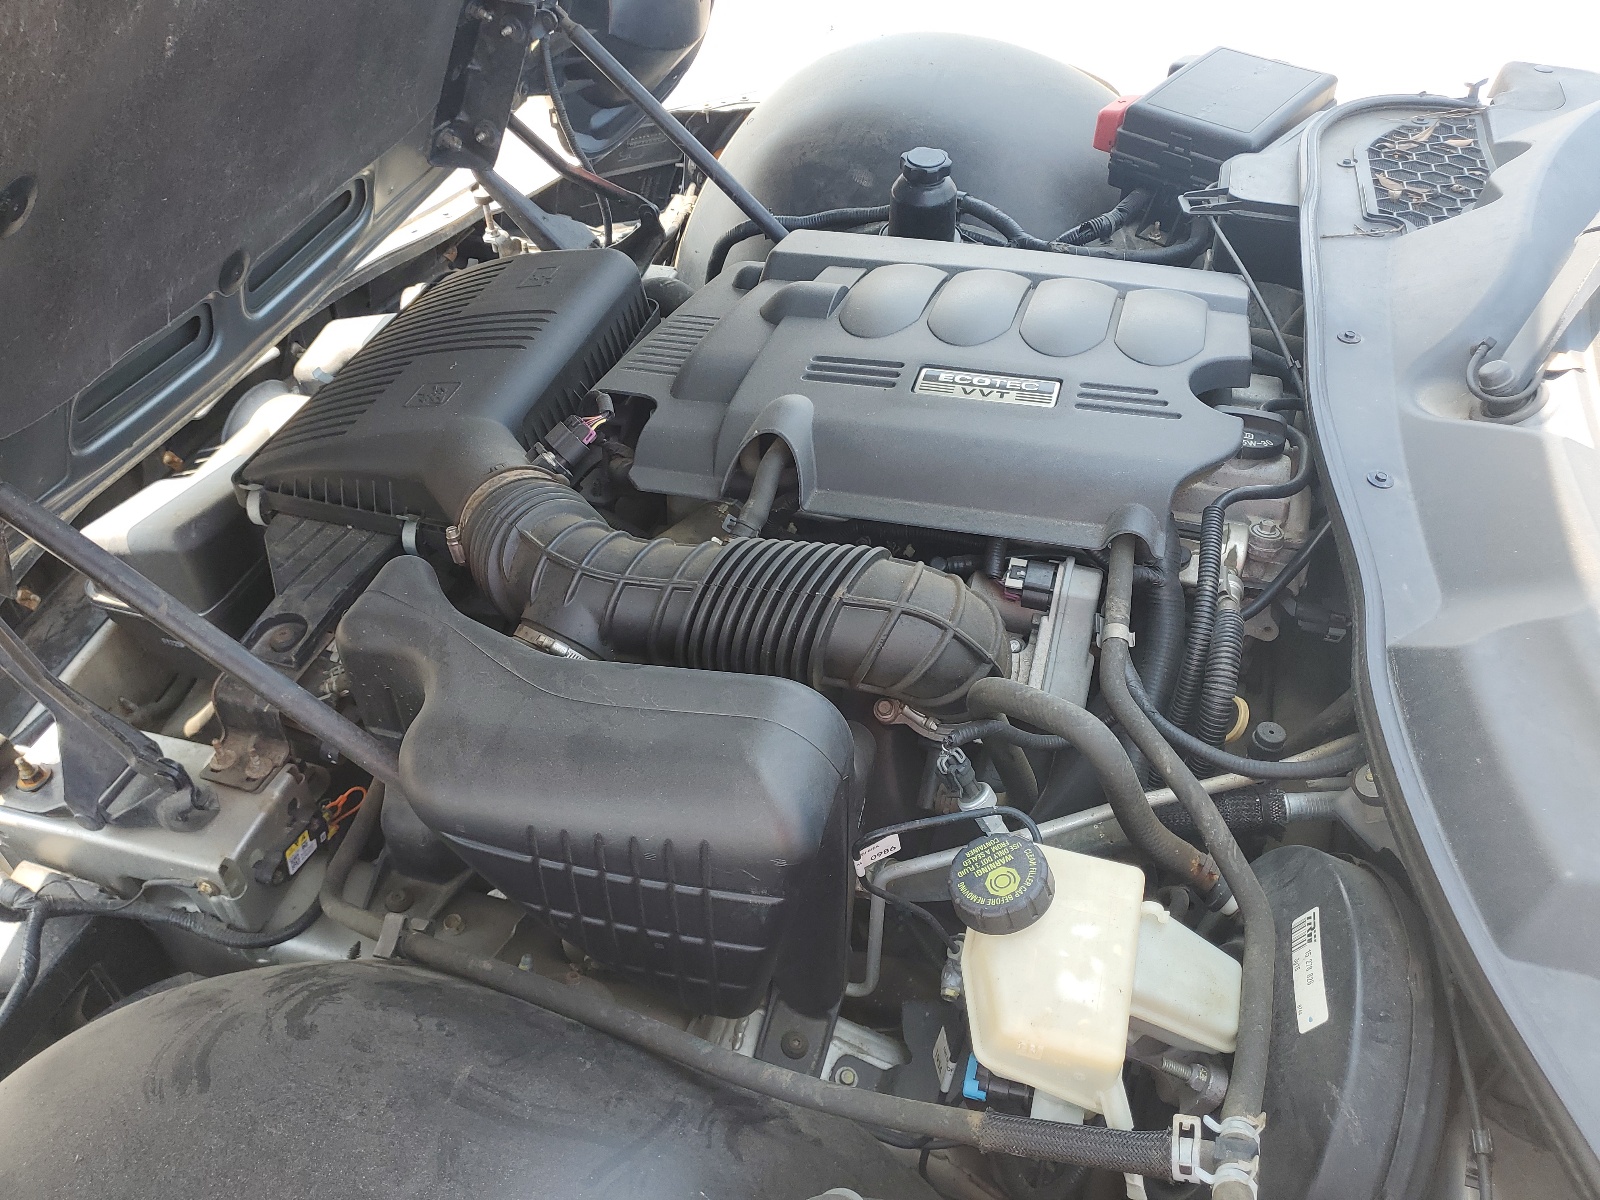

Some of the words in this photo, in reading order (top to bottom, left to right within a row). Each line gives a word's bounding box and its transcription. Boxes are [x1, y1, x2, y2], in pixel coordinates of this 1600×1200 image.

[938, 372, 1039, 391] ECOTEC
[961, 386, 1010, 399] VVT
[965, 837, 1000, 858] CONTAINER
[991, 840, 1010, 853] FROM
[993, 848, 1010, 859] ONLY
[1010, 842, 1023, 852] USE
[962, 852, 986, 867] SEALED
[980, 855, 994, 865] DOT
[1024, 848, 1037, 867] CLEAN
[957, 865, 976, 878] FLUID
[973, 854, 1014, 878] WARNING!
[1023, 867, 1037, 888] FILLER
[957, 881, 986, 905] REMOVING
[1014, 886, 1027, 898] CAP
[986, 895, 1014, 906] BEFORE
[1306, 911, 1317, 943] TRW
